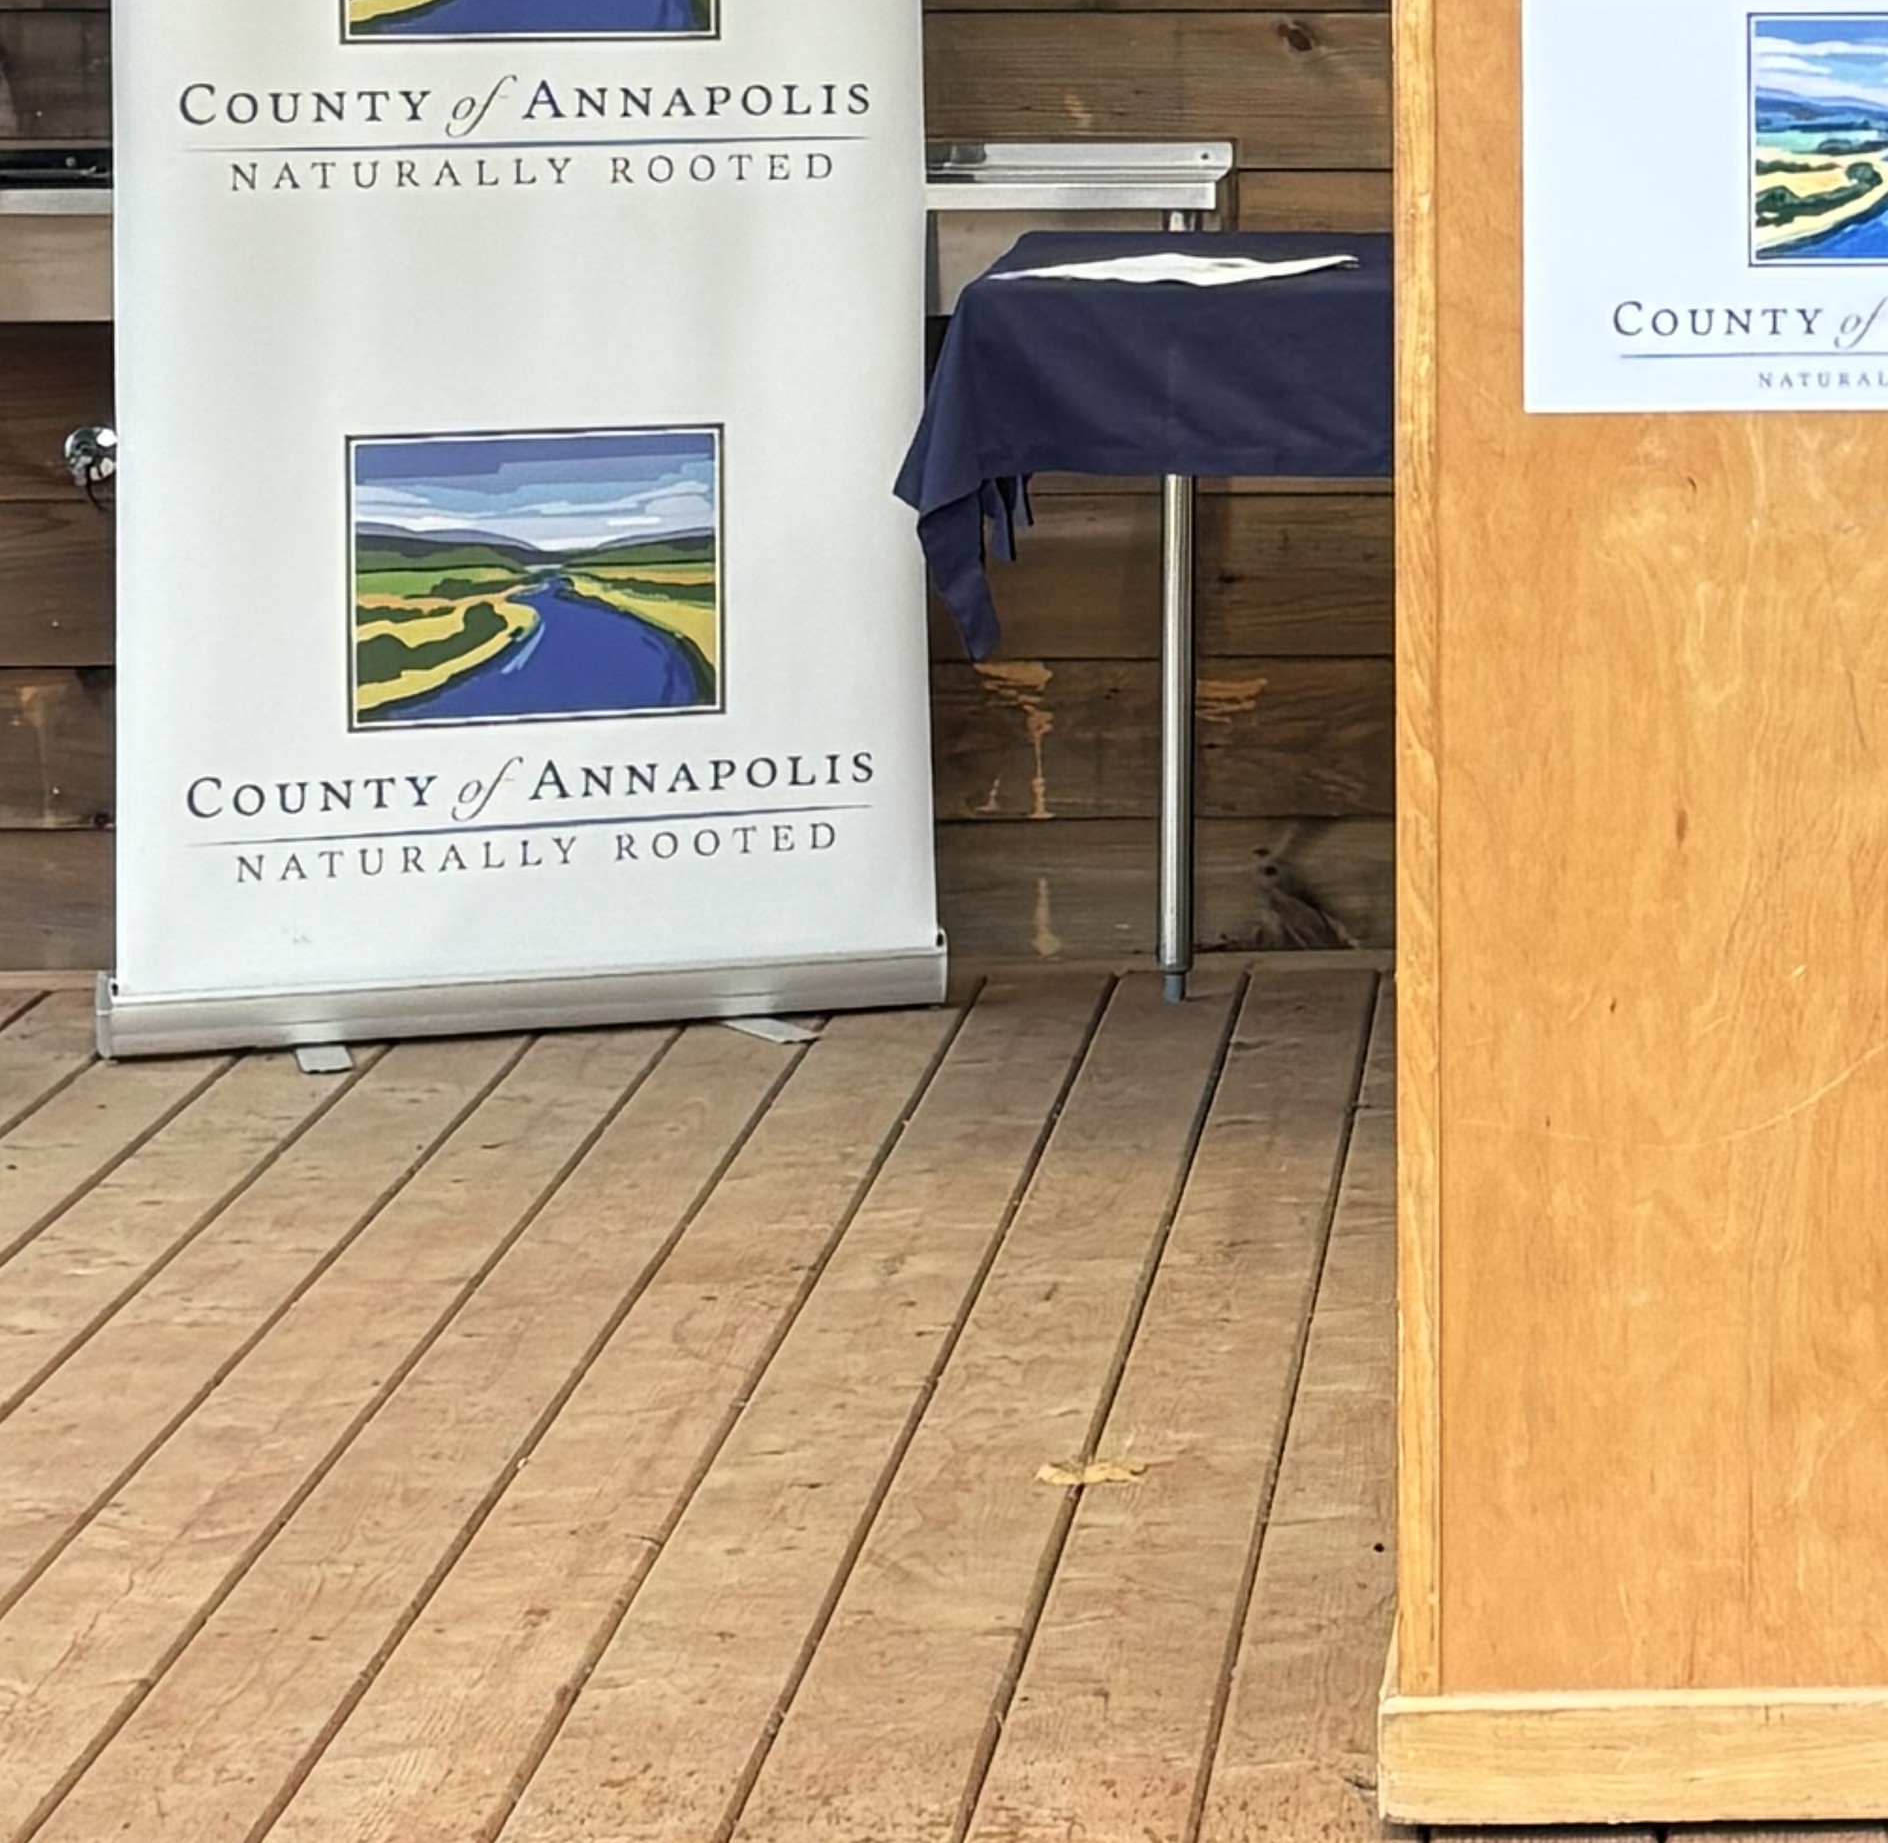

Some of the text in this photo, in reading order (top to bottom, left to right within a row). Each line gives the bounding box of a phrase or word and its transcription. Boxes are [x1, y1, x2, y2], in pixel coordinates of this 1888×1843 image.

[444, 74, 518, 138] of
[231, 152, 833, 192] NATURALLY ROOTED
[451, 755, 524, 822] of
[236, 822, 837, 883] NATURALLY ROOTED
